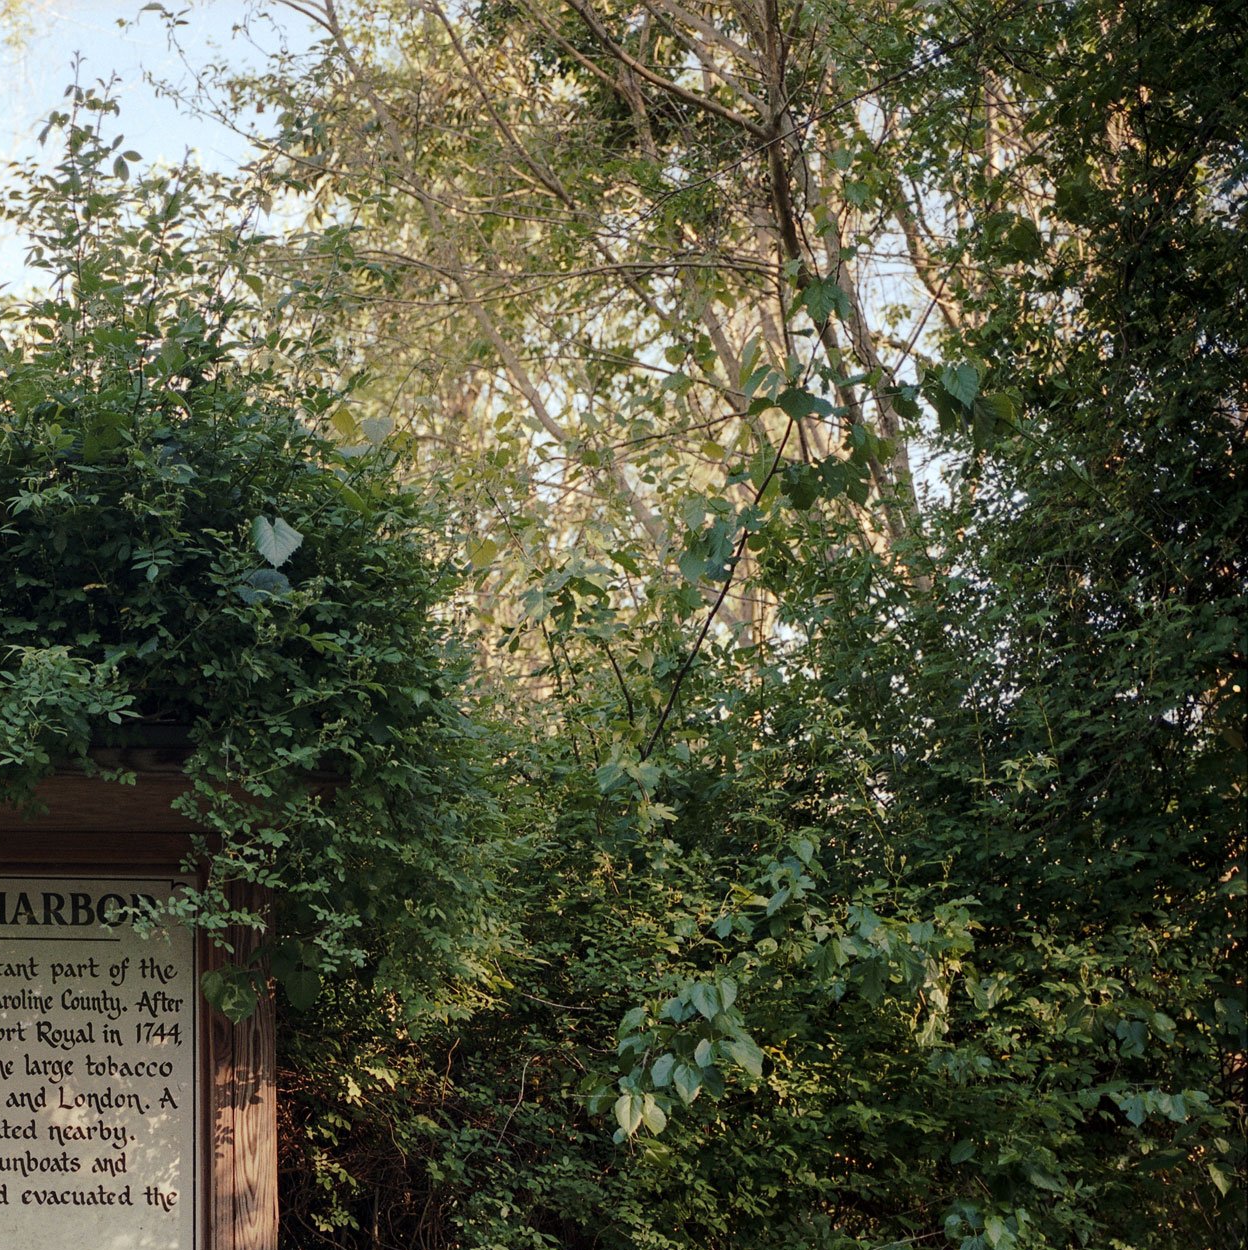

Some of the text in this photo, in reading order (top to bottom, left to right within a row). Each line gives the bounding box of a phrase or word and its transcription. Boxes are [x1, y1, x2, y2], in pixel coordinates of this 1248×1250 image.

[49, 956, 100, 985] part
[108, 956, 130, 987] of
[138, 956, 178, 985] the
[60, 988, 128, 1021] County.
[134, 990, 184, 1019] After
[35, 1020, 96, 1051] Royal
[102, 1023, 124, 1047] in
[135, 1022, 183, 1048] 1744,
[23, 1053, 74, 1085] large
[84, 1053, 174, 1078] tobacco
[5, 1085, 47, 1114] and
[58, 1085, 151, 1115] London.
[158, 1086, 178, 1110] A
[47, 1119, 136, 1150] nearby.
[91, 1151, 128, 1178] and
[21, 1184, 134, 1207] evacuated
[142, 1185, 178, 1213] the
